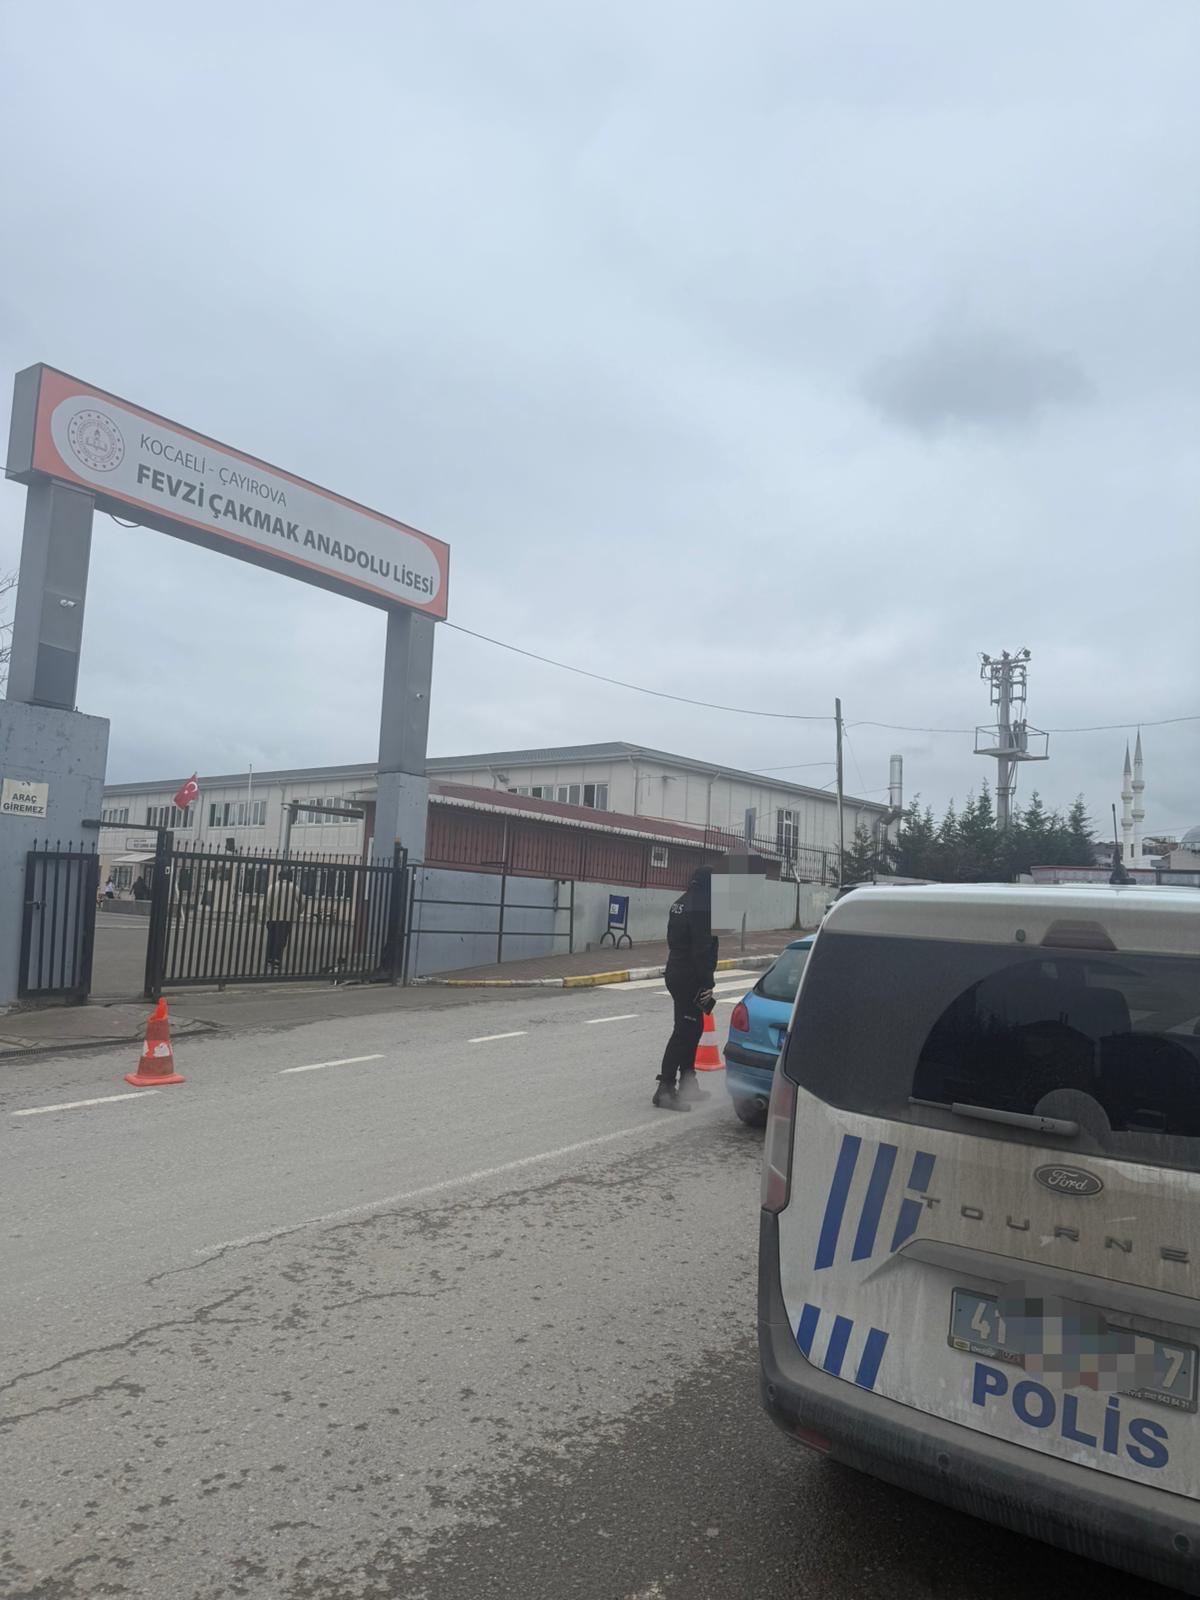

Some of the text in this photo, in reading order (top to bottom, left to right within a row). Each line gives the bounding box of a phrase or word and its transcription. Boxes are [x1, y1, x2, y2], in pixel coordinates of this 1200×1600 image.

[140, 433, 206, 475] KOCAELİ
[218, 467, 287, 507] ÇAYIROVA
[136, 463, 434, 595] FEVZİ ÇAKMAK ANADOLU LİSESİ
[3, 802, 45, 814] GİREMEZ
[12, 793, 38, 804] ARAÇ
[1047, 1168, 1089, 1193] Ford
[972, 1361, 1169, 1469] POLİS
